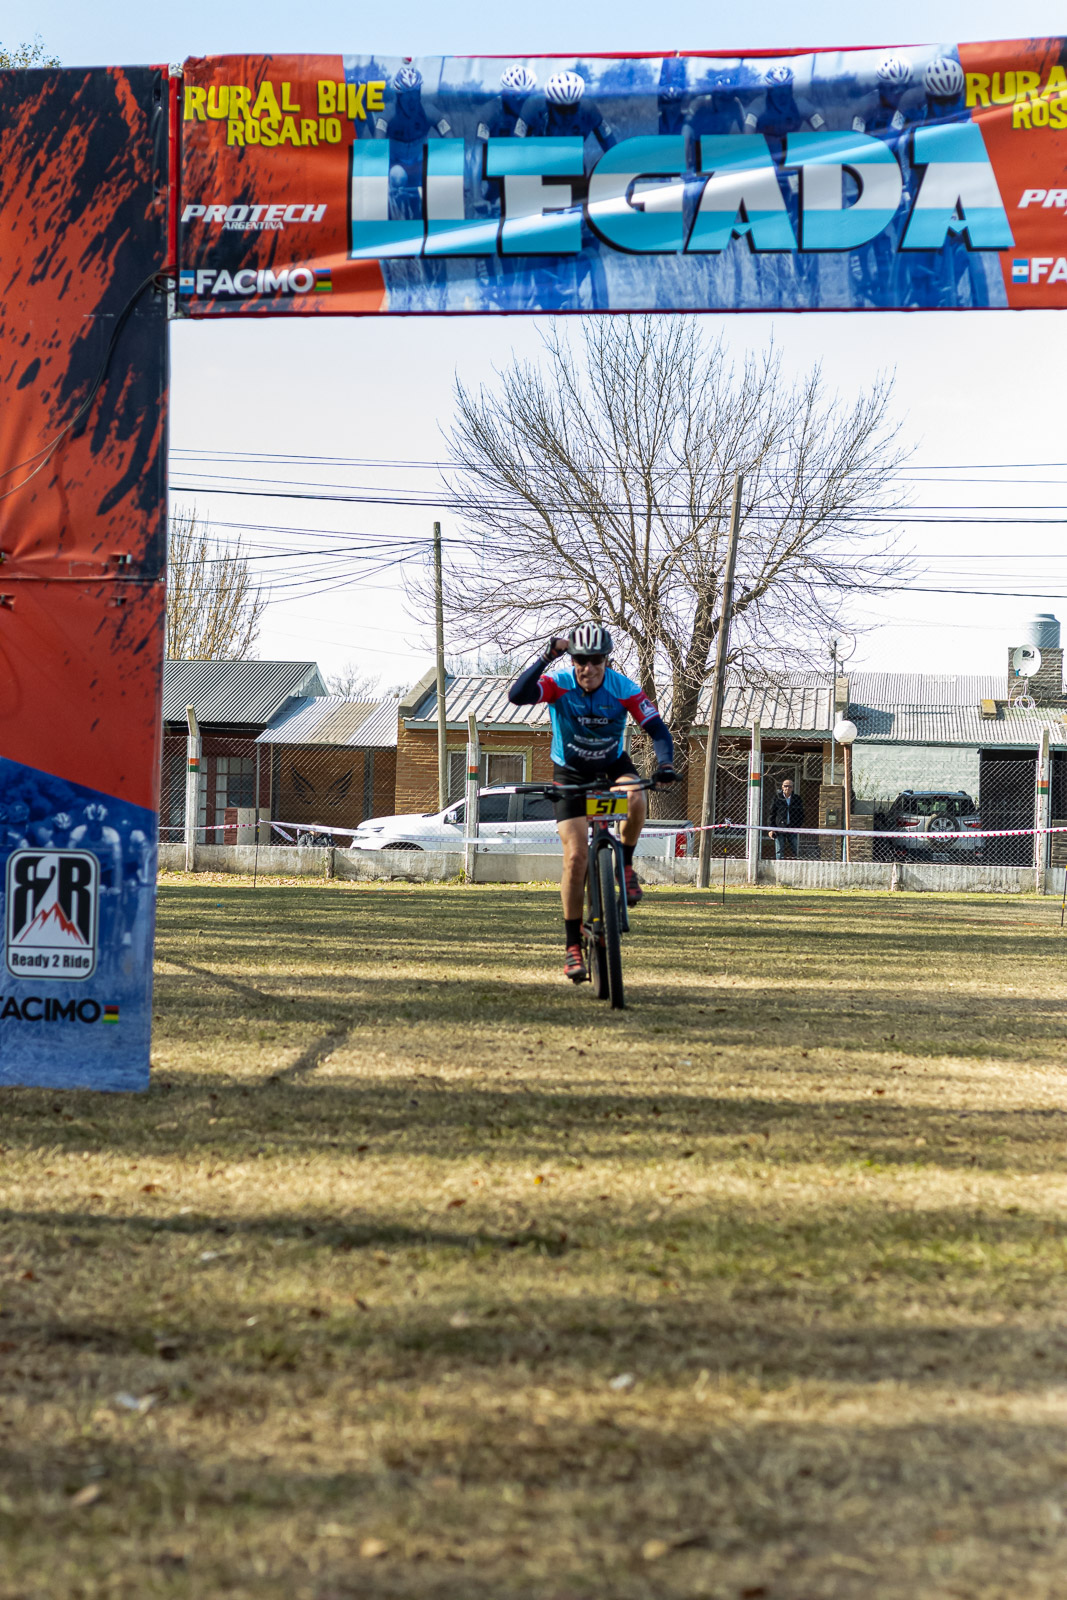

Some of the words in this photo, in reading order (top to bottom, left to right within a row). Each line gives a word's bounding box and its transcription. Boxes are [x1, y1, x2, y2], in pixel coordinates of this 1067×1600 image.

[184, 81, 301, 121] RURAL
[318, 80, 386, 120] BIKE
[227, 116, 342, 146] ROSARIO
[348, 123, 1015, 259] LLEGADA
[181, 204, 327, 222] PROTECH
[222, 221, 284, 230] ARGENTINA
[196, 268, 314, 294] FACIMO
[595, 799, 618, 815] 51
[12, 953, 50, 968] Ready
[52, 954, 60, 968] 2
[63, 954, 90, 968] Ride
[0, 996, 101, 1023] ACIMO
